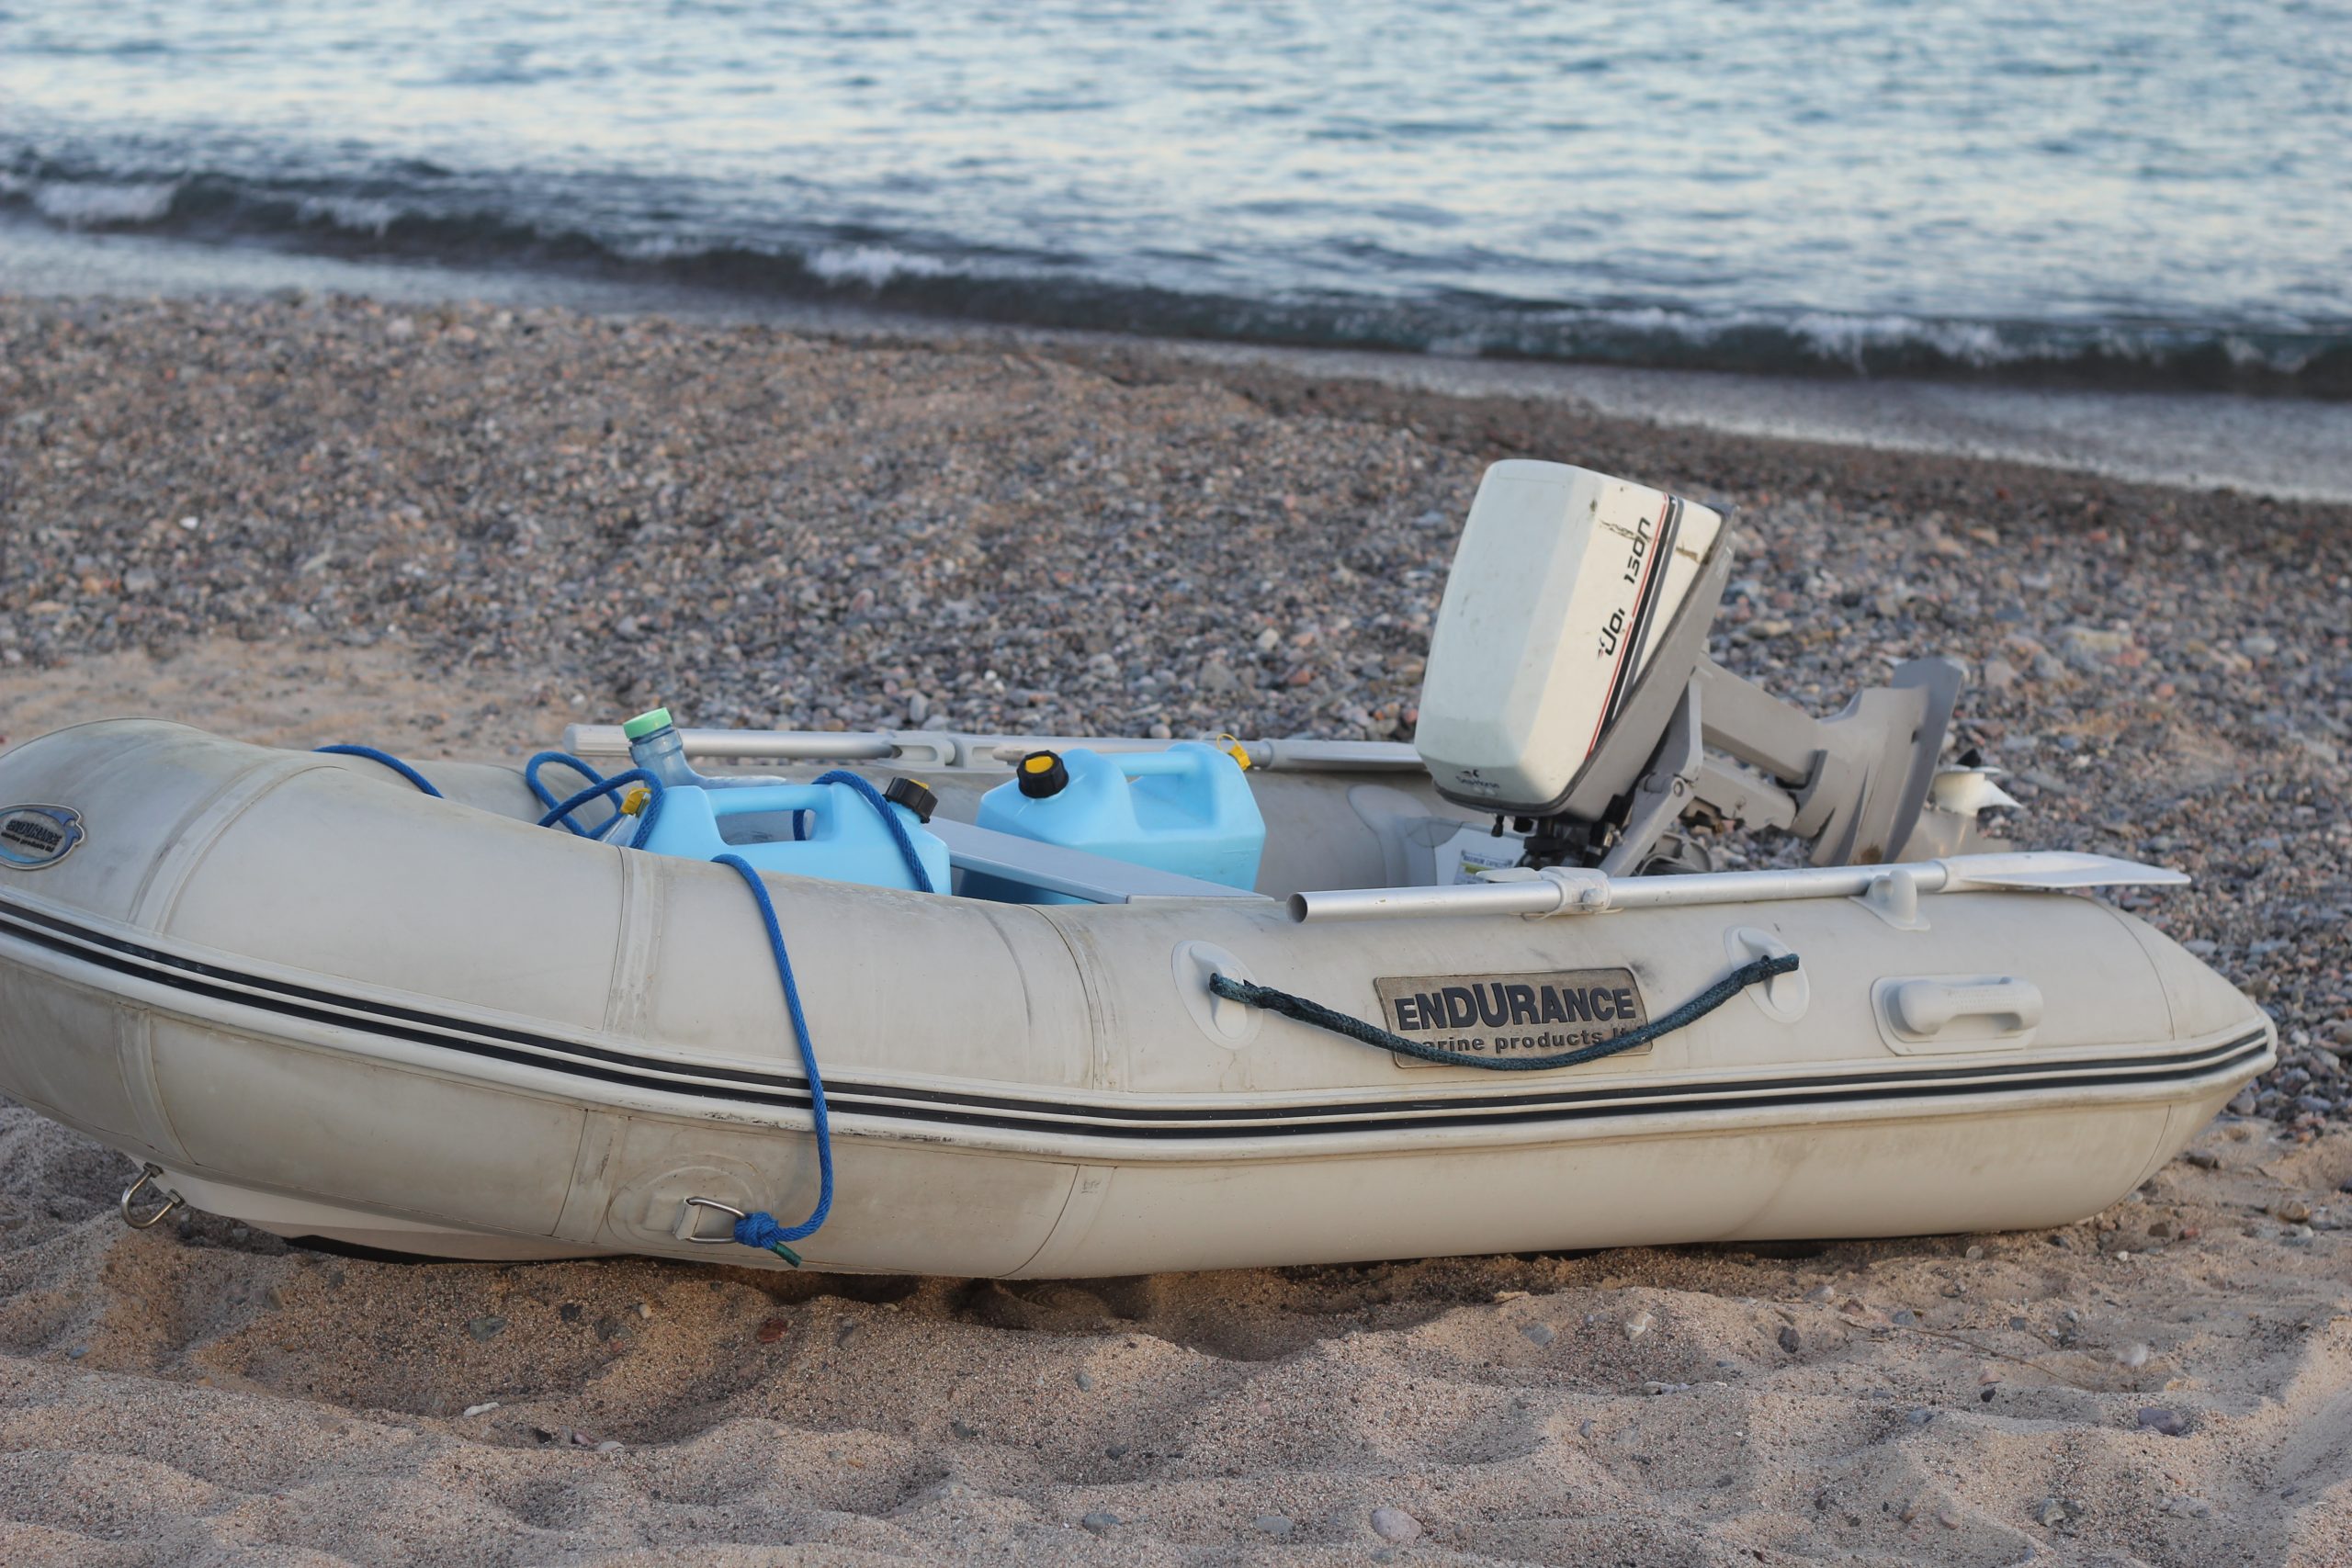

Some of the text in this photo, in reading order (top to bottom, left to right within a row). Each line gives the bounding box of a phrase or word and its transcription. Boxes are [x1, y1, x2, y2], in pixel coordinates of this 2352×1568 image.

[1394, 982, 1636, 1031] ENDURANCE
[1422, 1036, 1485, 1052] arine
[1495, 1029, 1603, 1054] products
